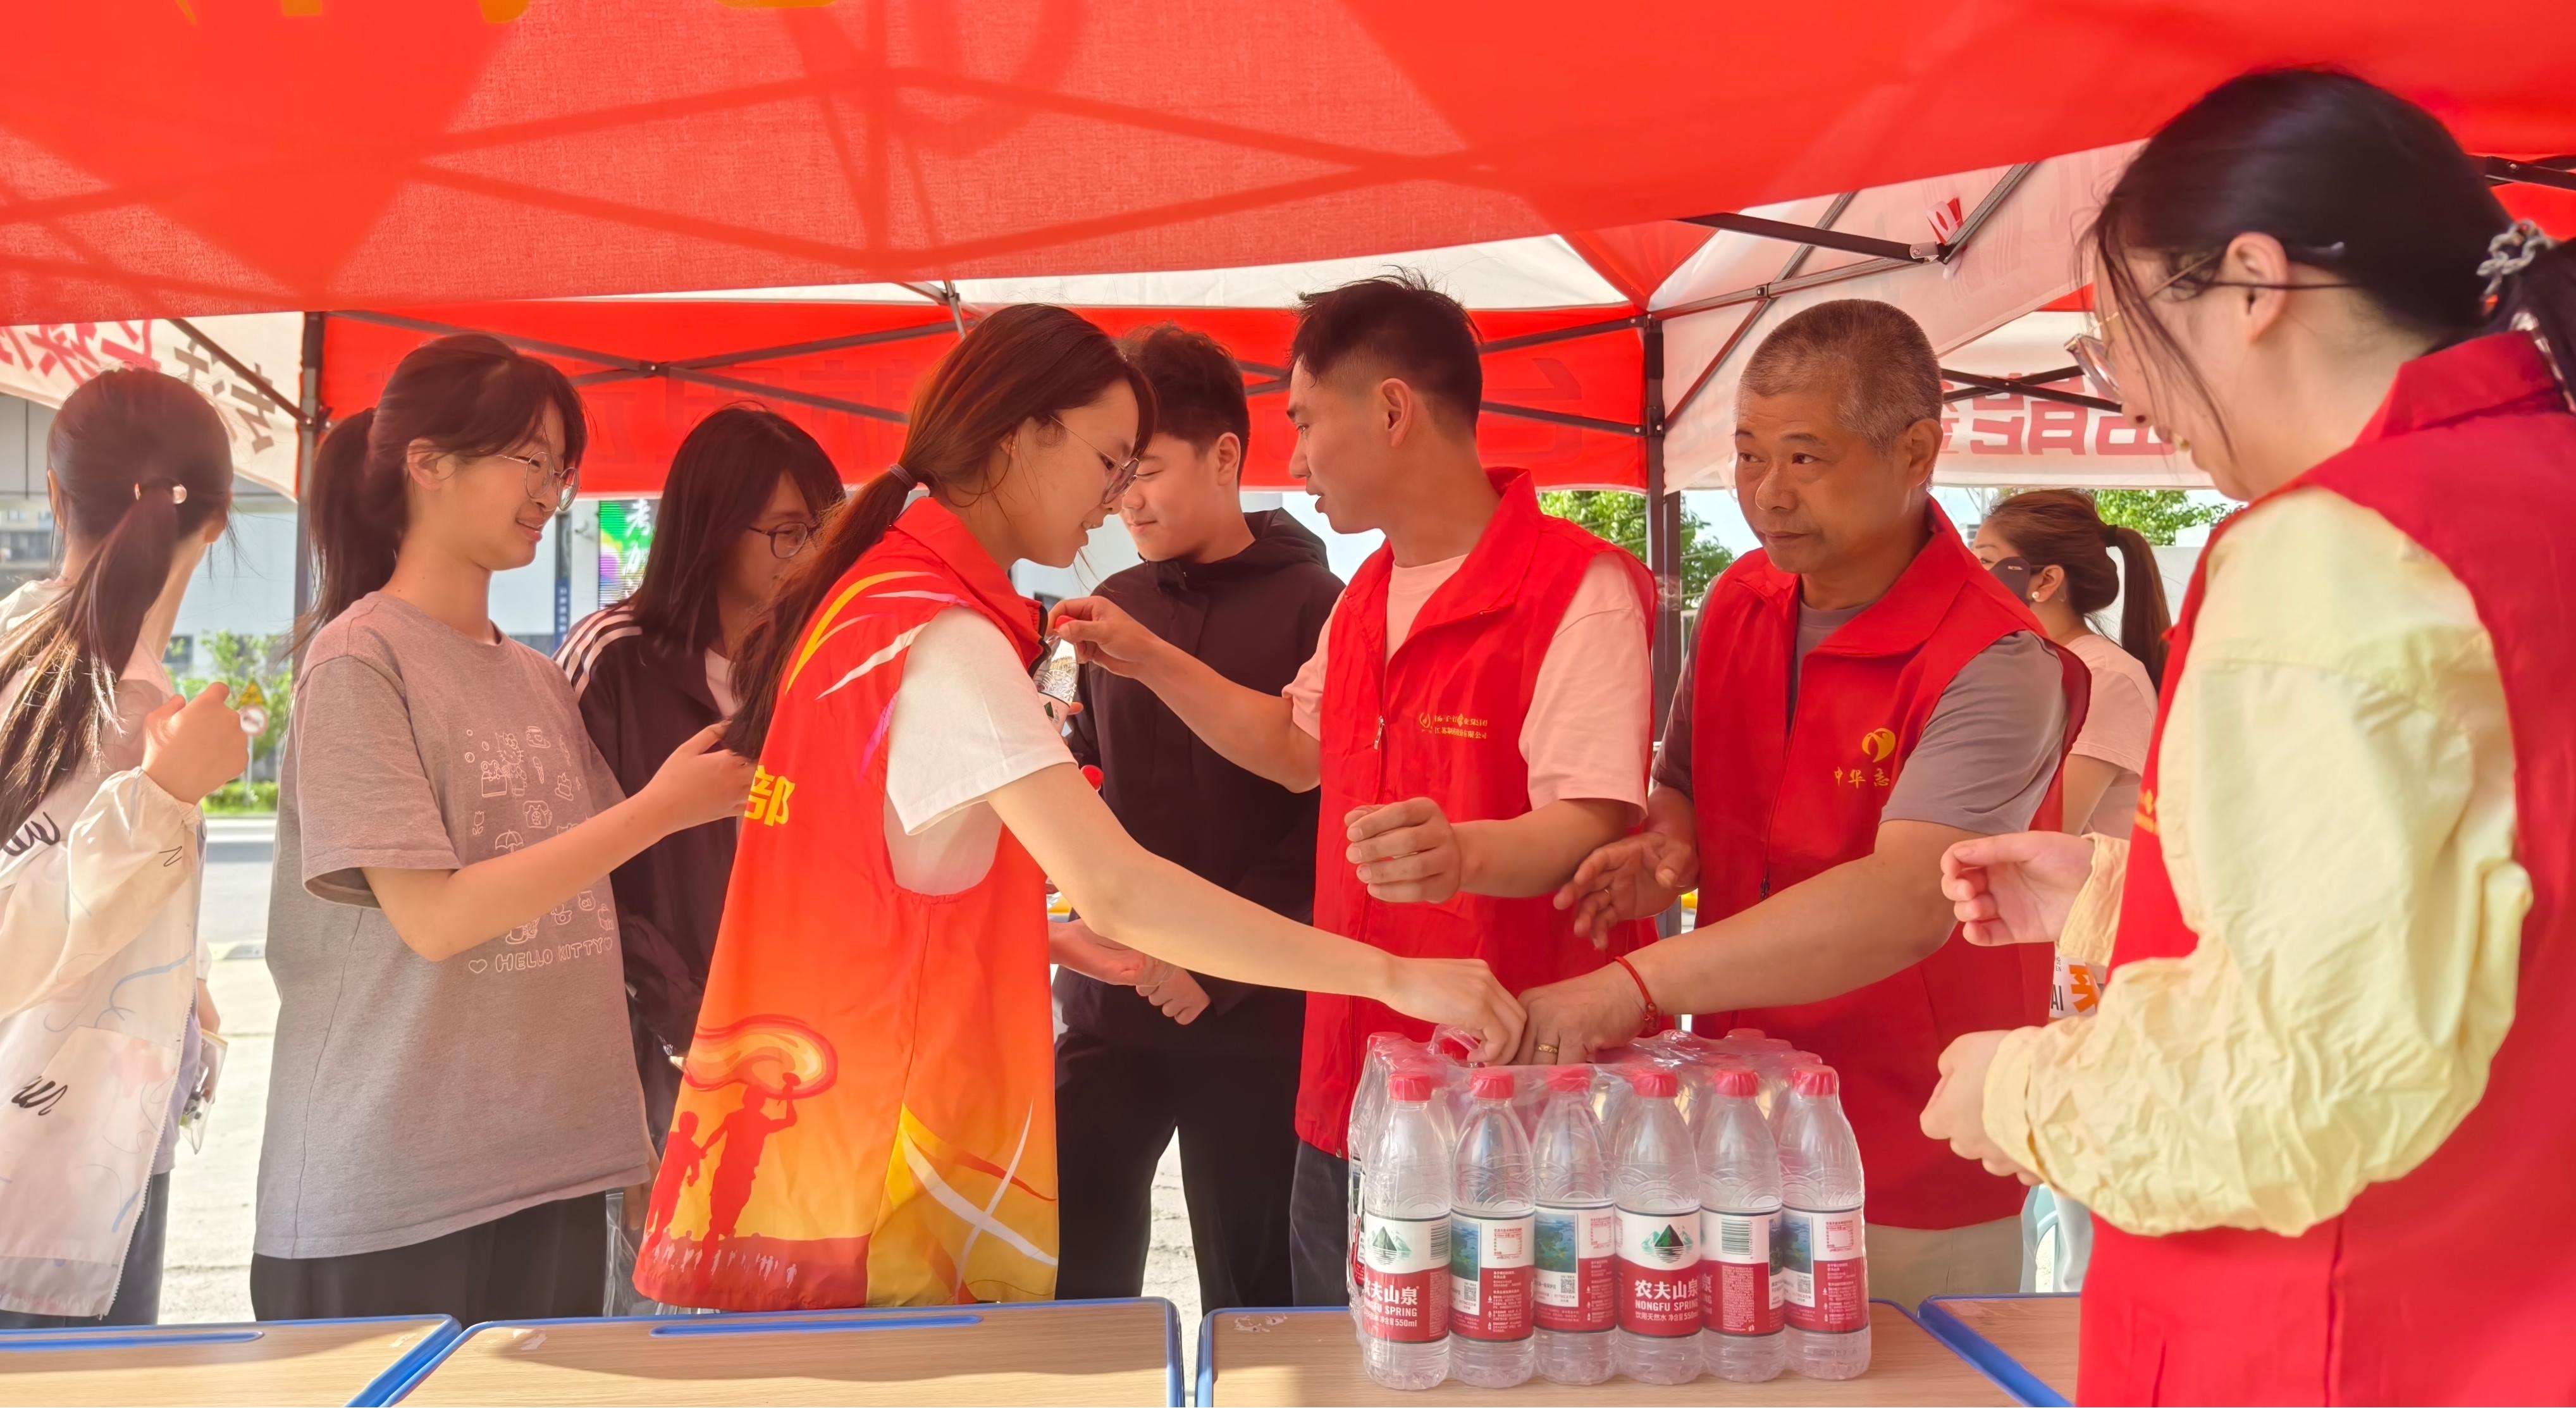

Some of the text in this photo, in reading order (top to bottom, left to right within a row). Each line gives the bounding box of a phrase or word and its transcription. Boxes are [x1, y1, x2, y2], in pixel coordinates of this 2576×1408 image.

[744, 765, 796, 827] 部
[495, 937, 603, 972] HELLO KITTY
[1634, 1278, 1698, 1300] 农夫山泉
[1384, 1305, 1417, 1317] SPRING
[1635, 1299, 1670, 1311] NONGFU
[1673, 1298, 1698, 1311] SPRING
[1636, 1311, 1667, 1321] 饮用天然水
